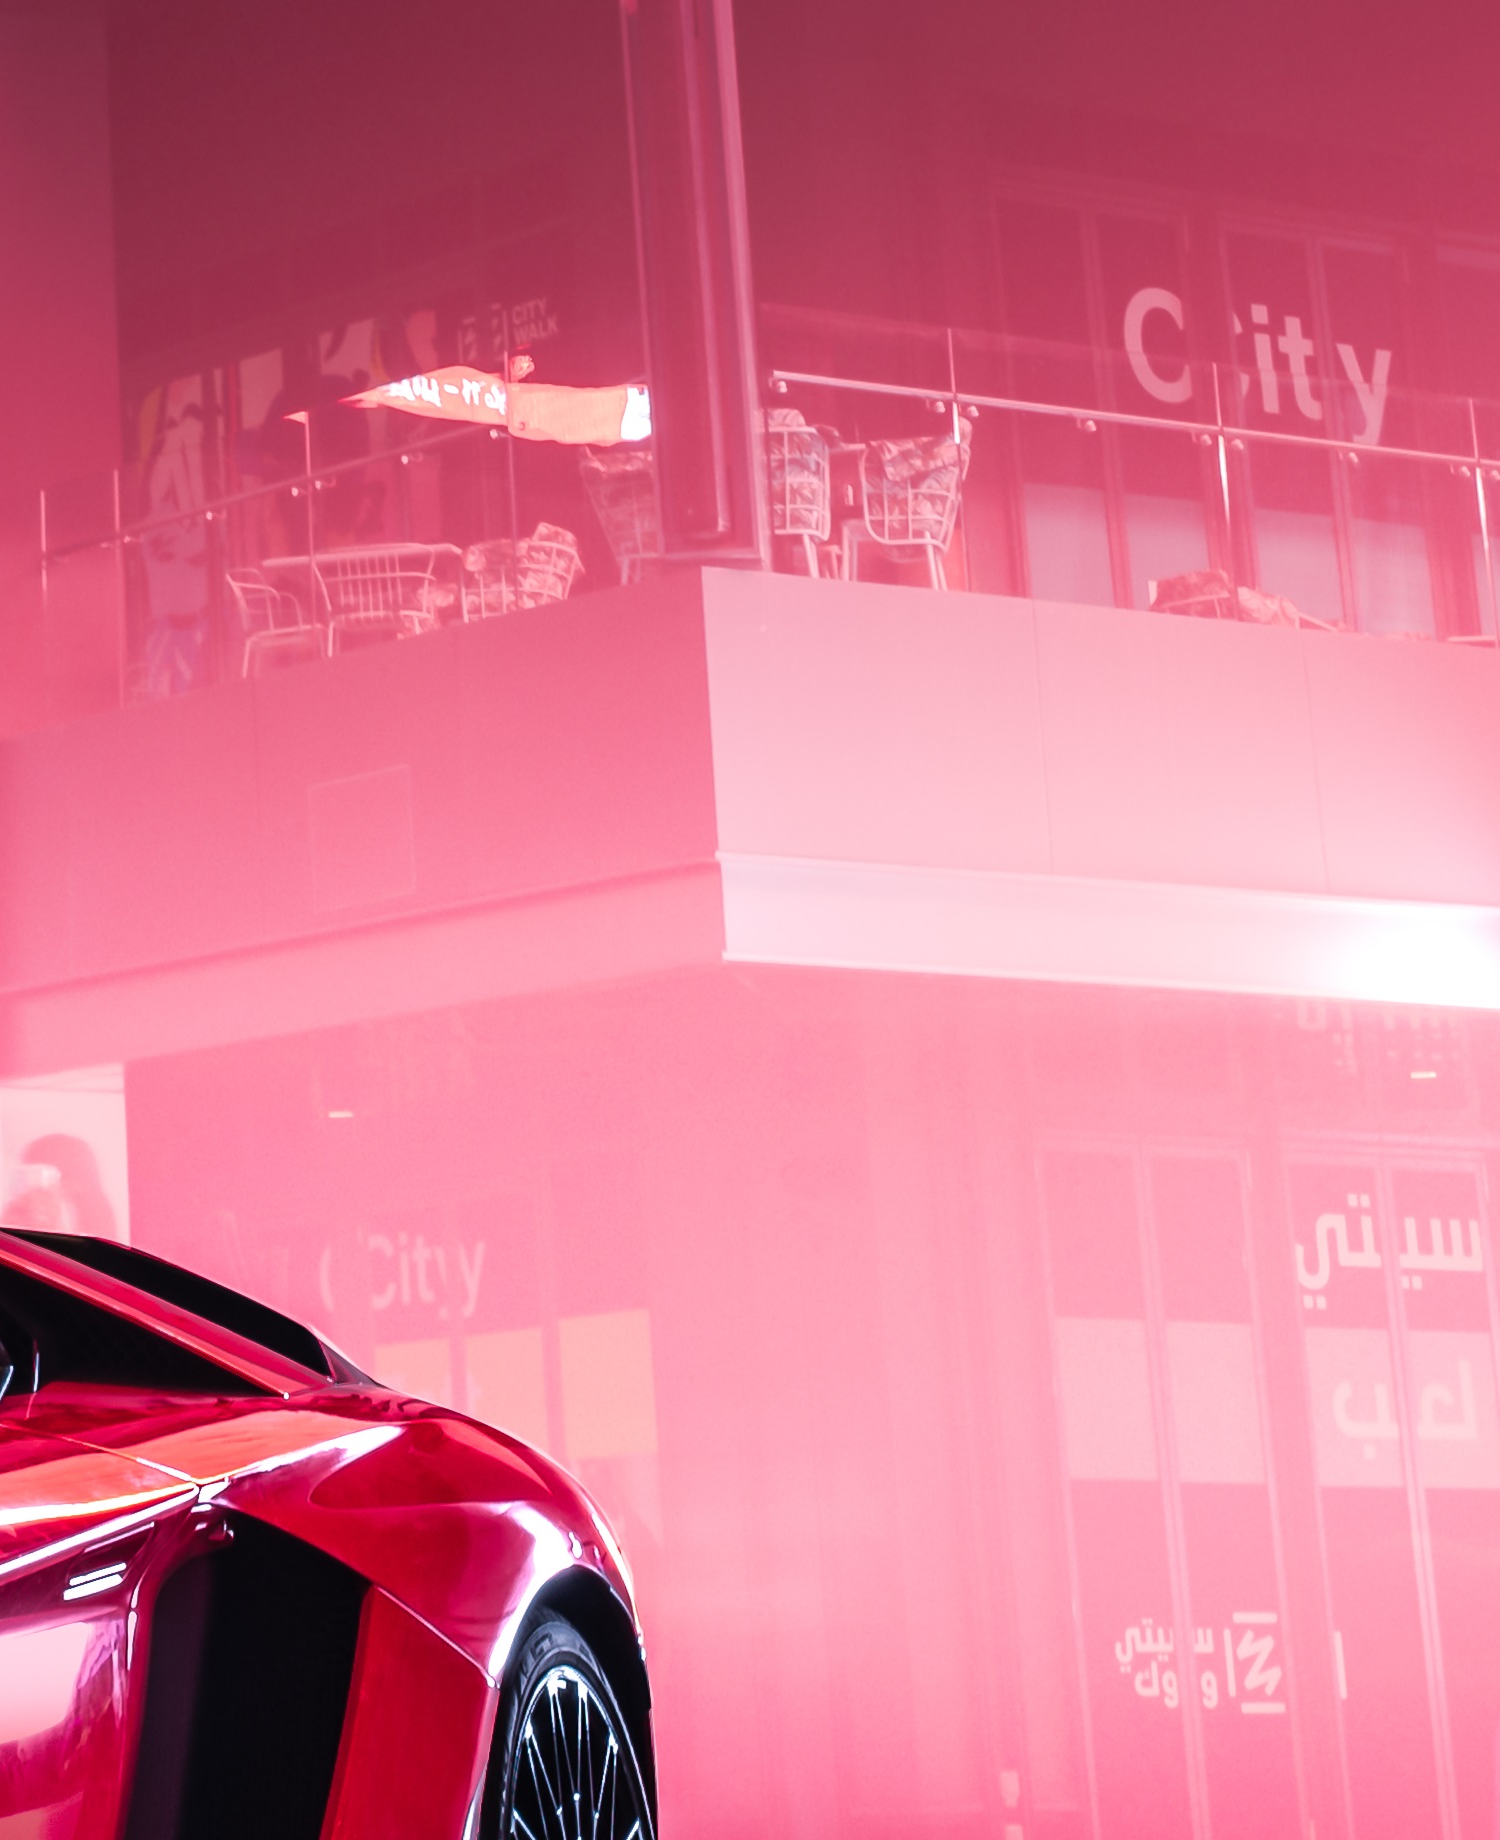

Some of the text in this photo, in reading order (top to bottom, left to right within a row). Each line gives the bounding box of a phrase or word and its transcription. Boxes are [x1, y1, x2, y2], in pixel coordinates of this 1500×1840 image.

[511, 296, 548, 326] CITY
[513, 314, 559, 346] WALK
[1123, 286, 1392, 446] City
[318, 1228, 486, 1320] City
[1294, 1193, 1484, 1310] سيتي
[1114, 1616, 1215, 1674] سيتي
[1133, 1659, 1220, 1710] ووك
